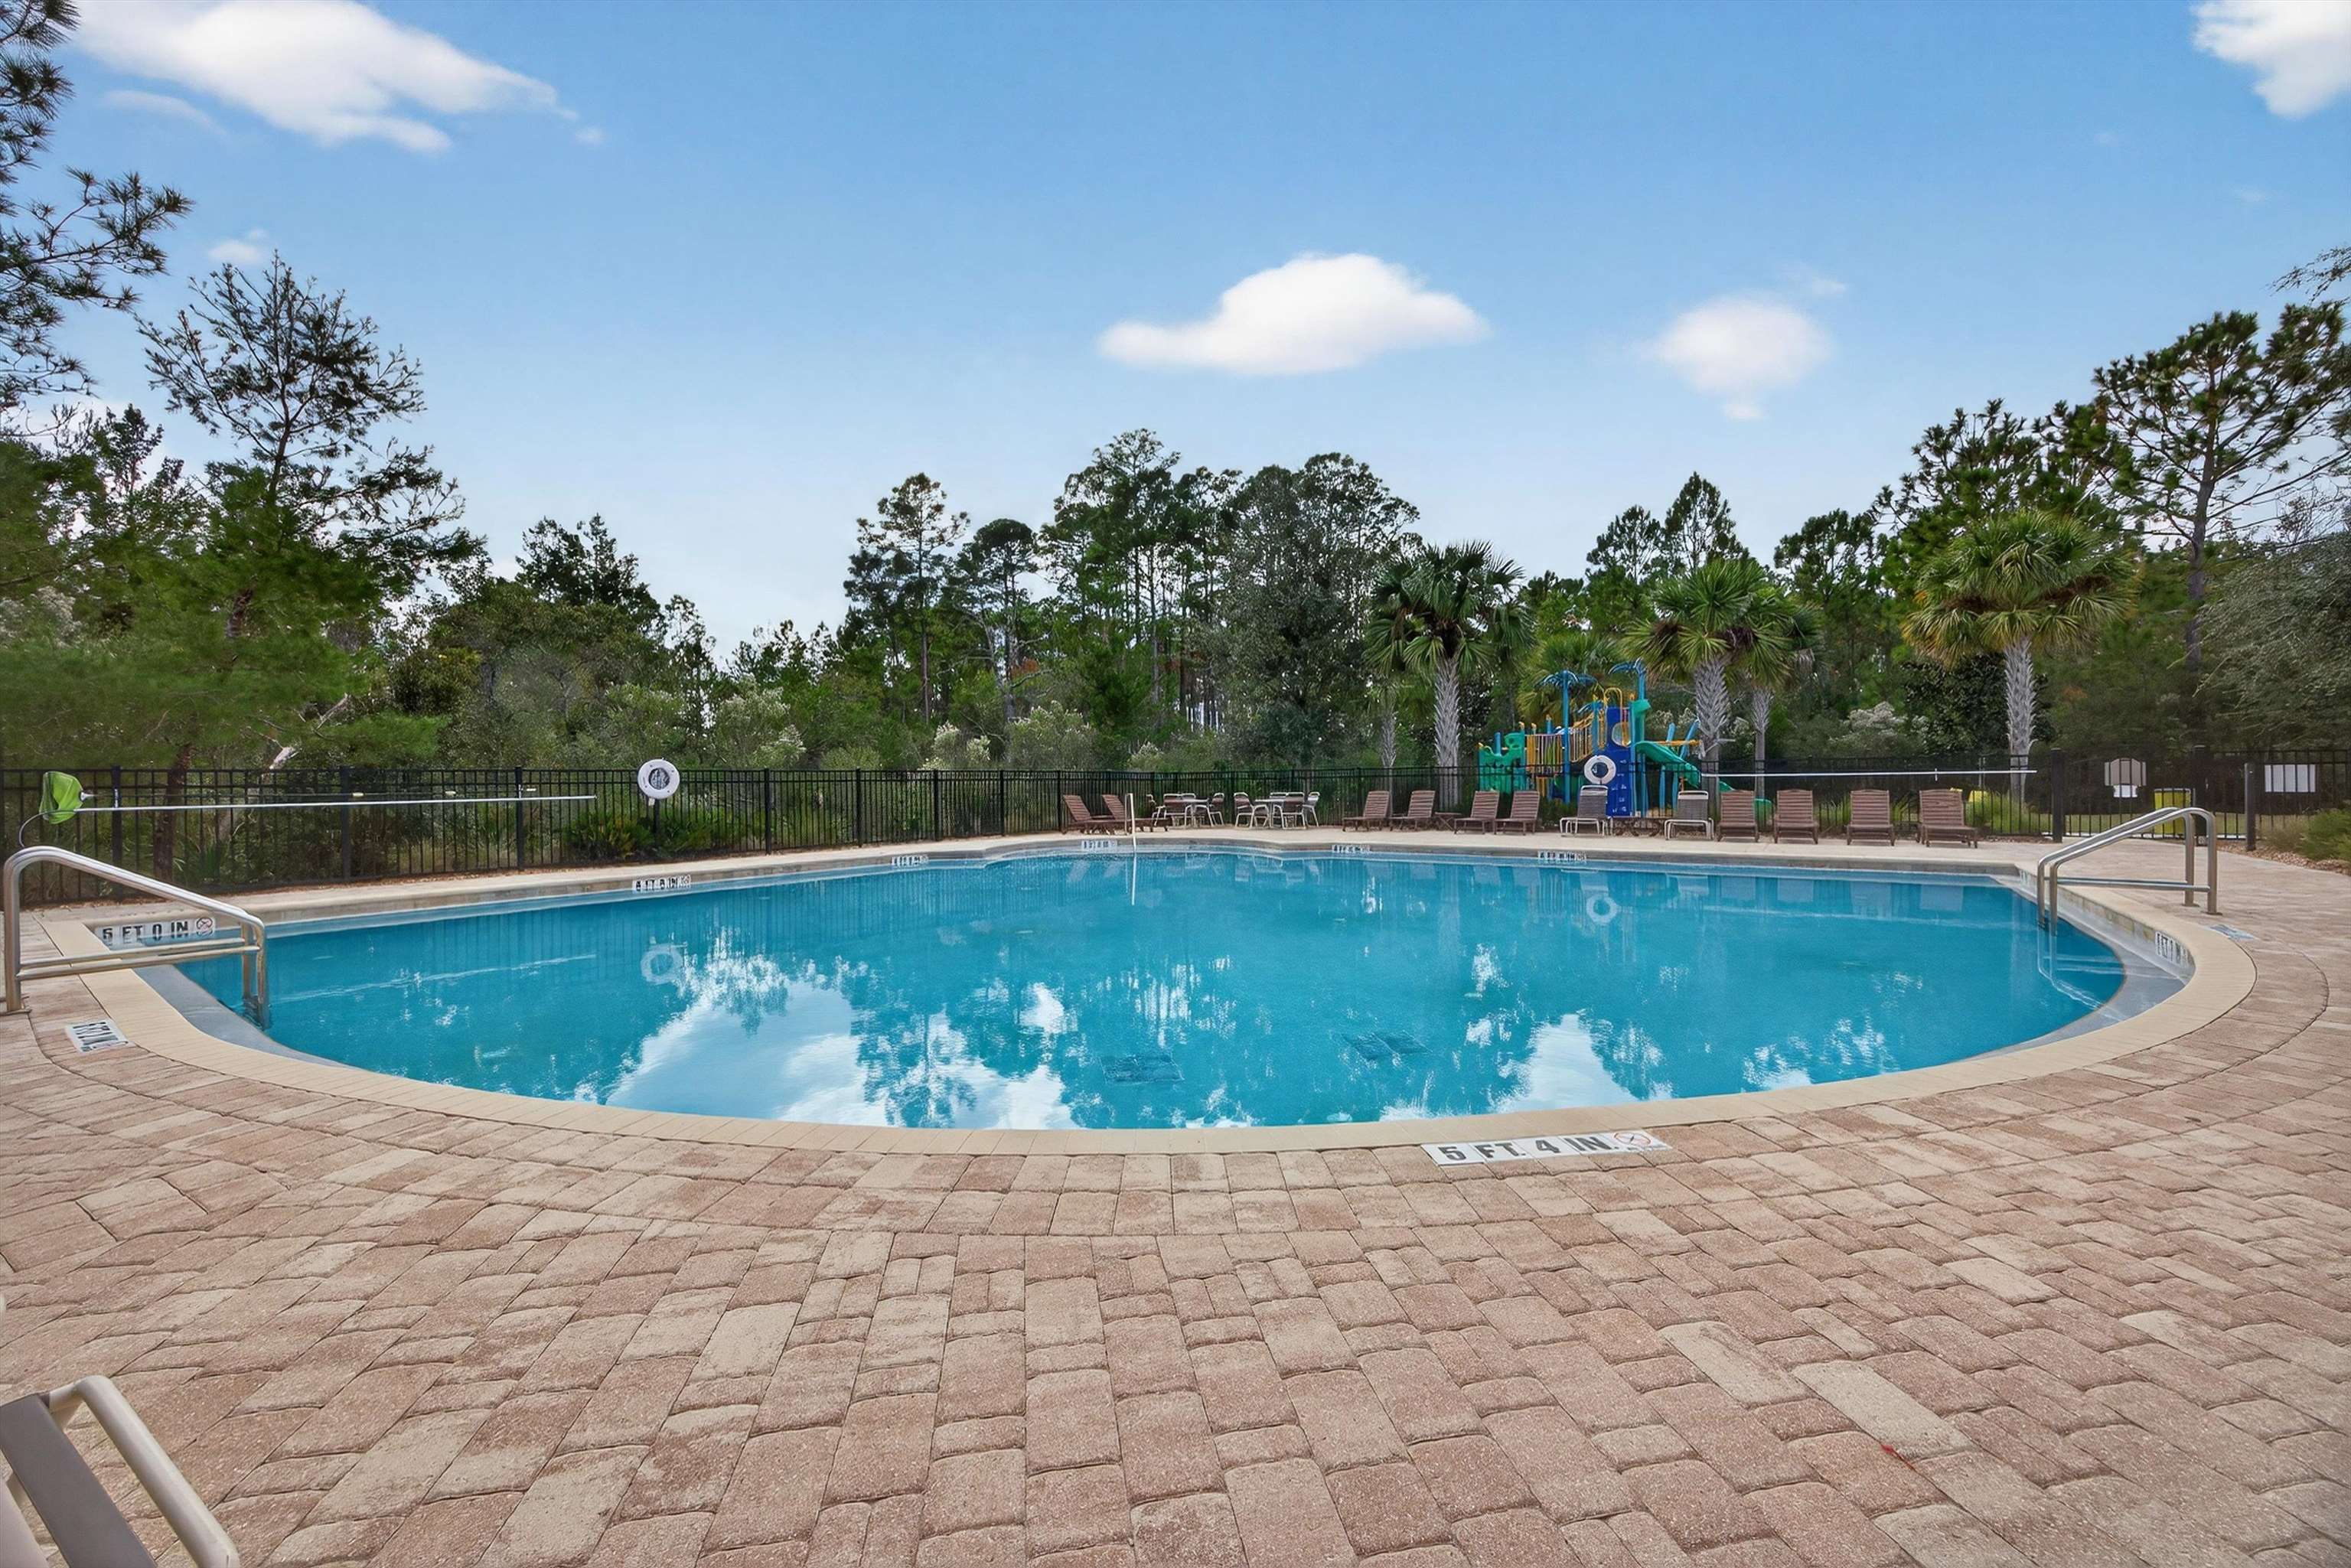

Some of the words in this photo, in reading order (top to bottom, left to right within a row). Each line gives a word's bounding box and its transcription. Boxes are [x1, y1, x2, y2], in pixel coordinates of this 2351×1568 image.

[171, 921, 188, 938] IN
[1438, 1146, 1466, 1161] 5
[1536, 1139, 1560, 1154] 4
